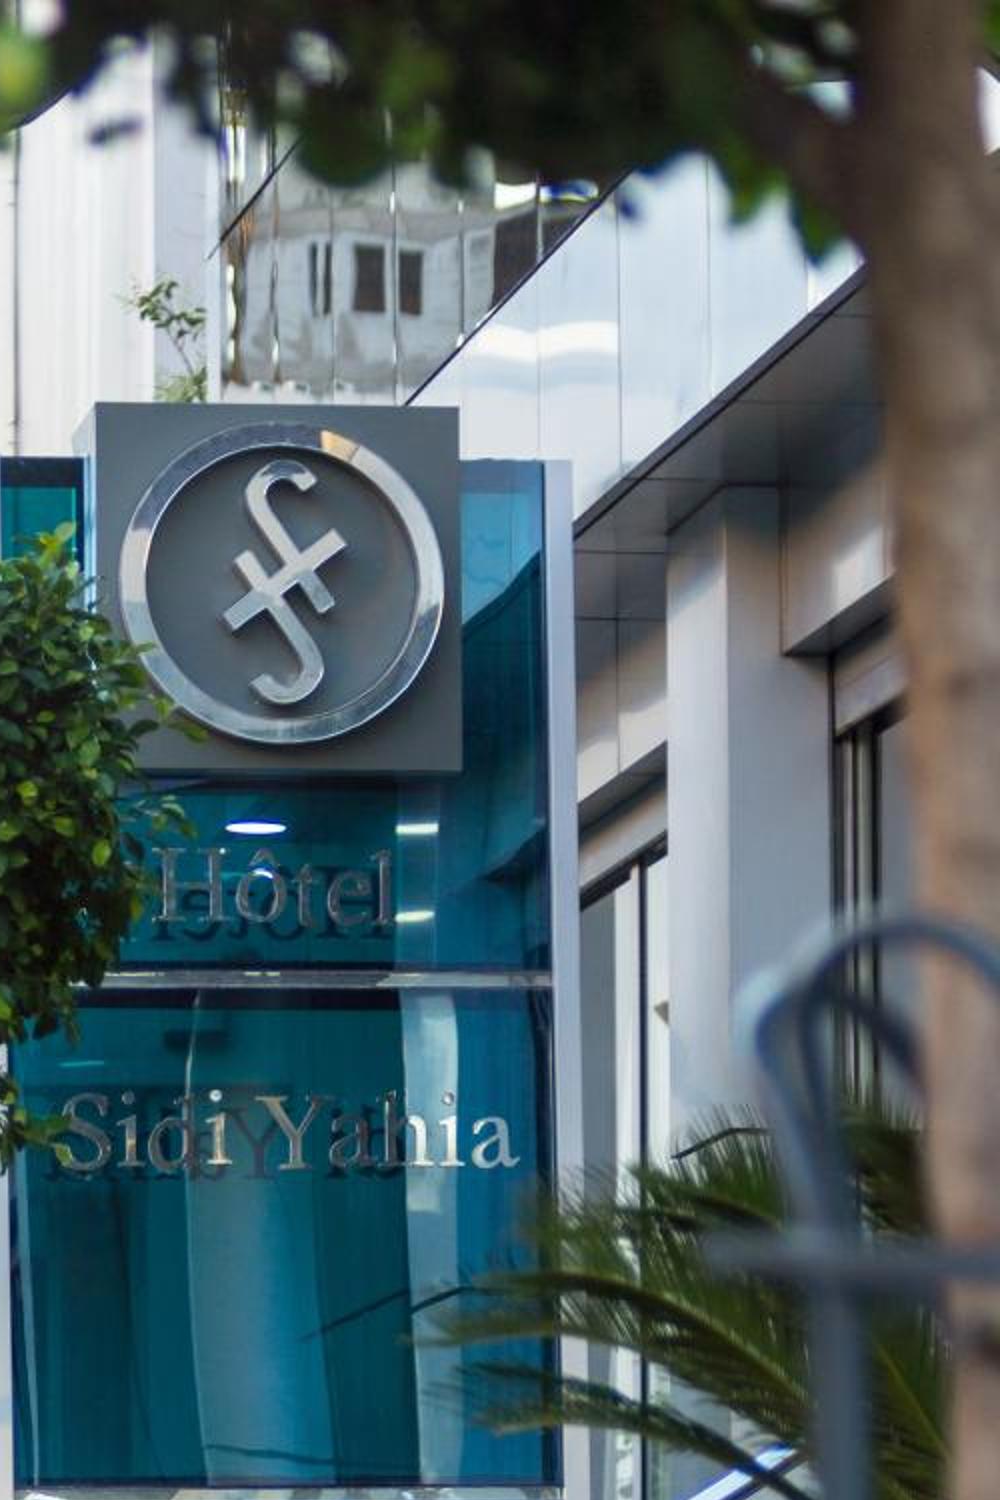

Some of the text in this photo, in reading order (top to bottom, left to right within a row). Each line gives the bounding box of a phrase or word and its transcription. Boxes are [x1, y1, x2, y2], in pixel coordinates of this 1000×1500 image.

[151, 847, 395, 927] Hôtel
[55, 1090, 521, 1175] Sidi Yahia
